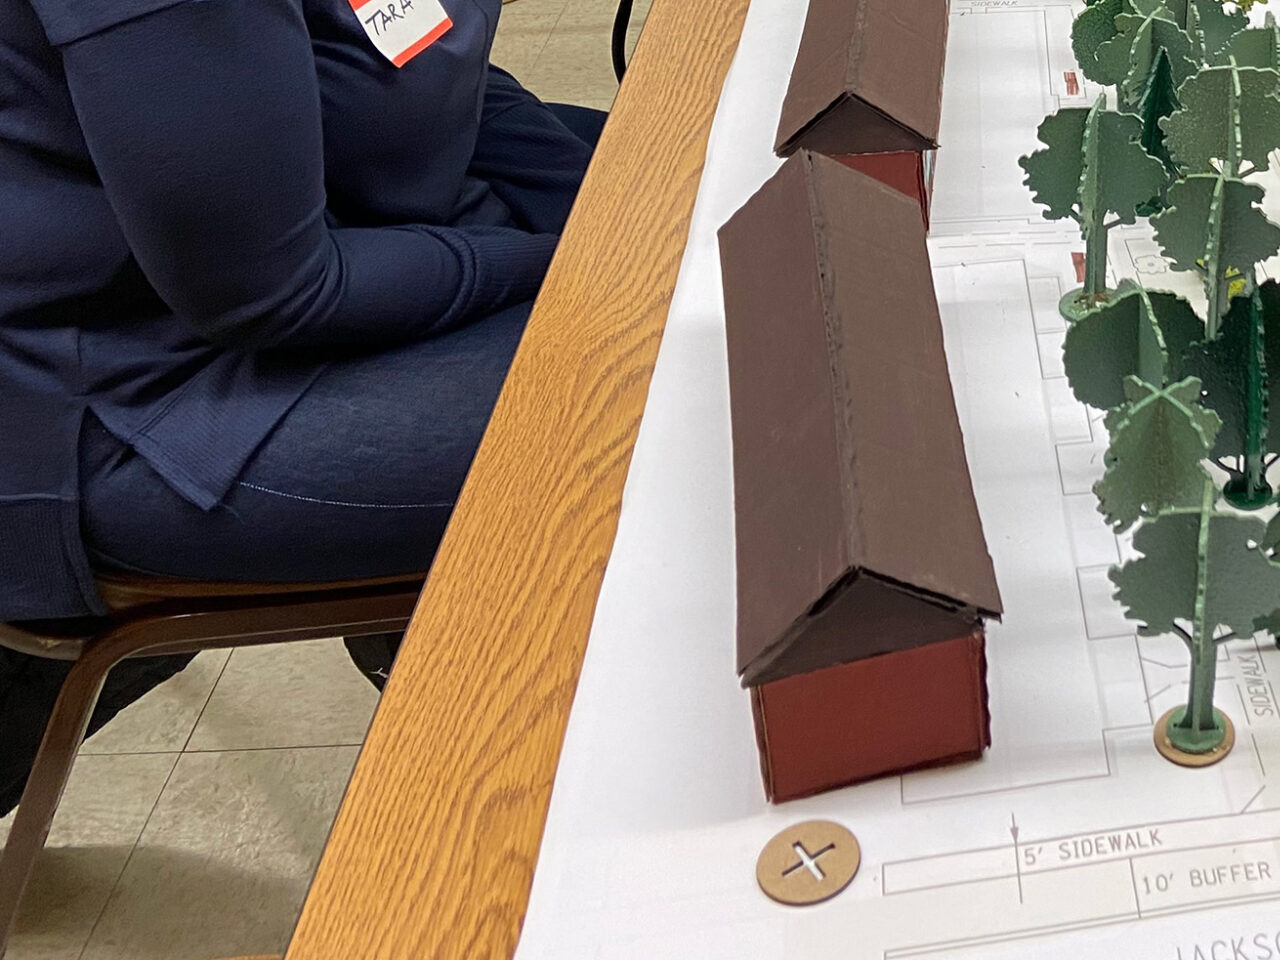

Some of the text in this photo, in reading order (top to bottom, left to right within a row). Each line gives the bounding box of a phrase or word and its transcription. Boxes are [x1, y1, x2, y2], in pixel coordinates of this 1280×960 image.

[1237, 654, 1274, 717] SIDEWALK
[1024, 828, 1163, 866] 5' SIDEWALK
[1141, 861, 1272, 894] 10' BUFFER
